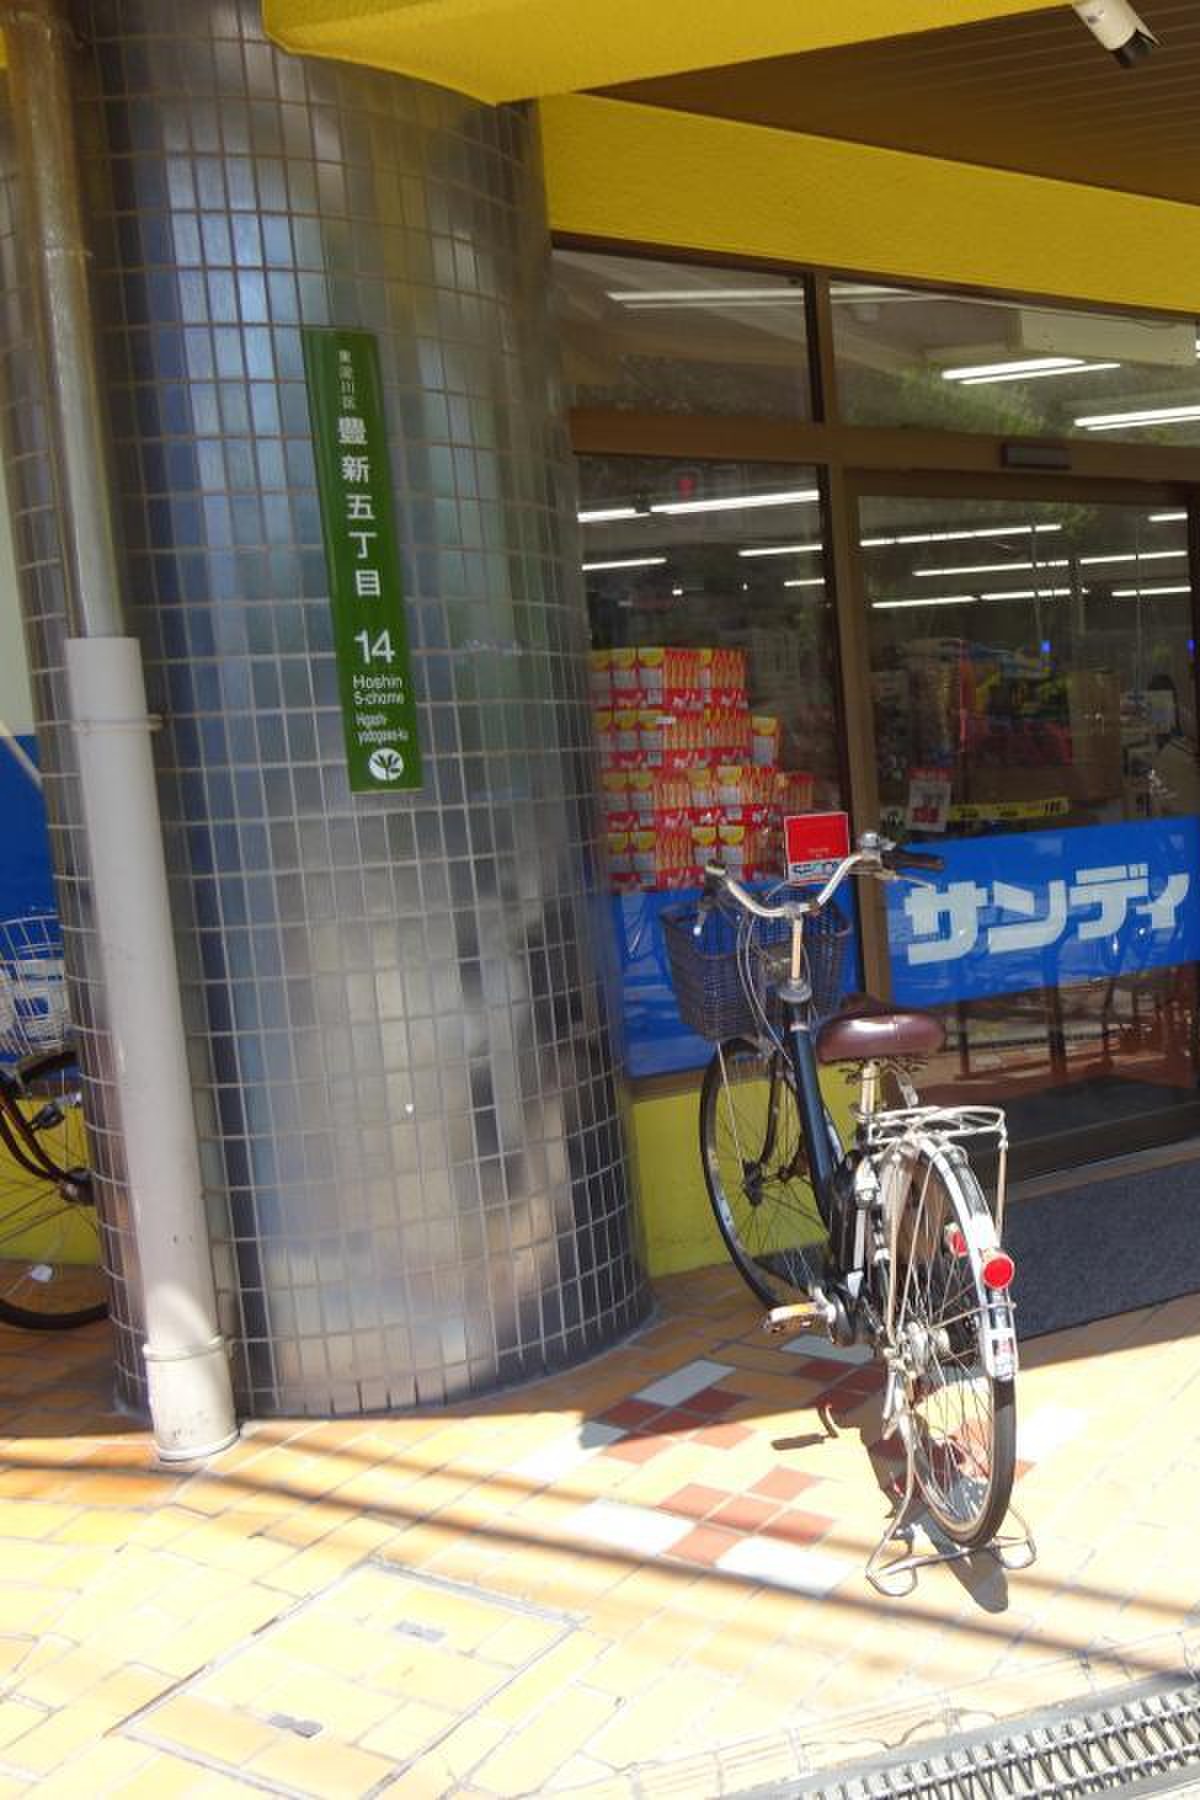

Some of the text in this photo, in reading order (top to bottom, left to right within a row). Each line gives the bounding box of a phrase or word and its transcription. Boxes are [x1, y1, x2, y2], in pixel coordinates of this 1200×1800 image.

[353, 629, 396, 664] 14
[352, 673, 403, 689] Hoshin
[903, 862, 1191, 967] サンディ
